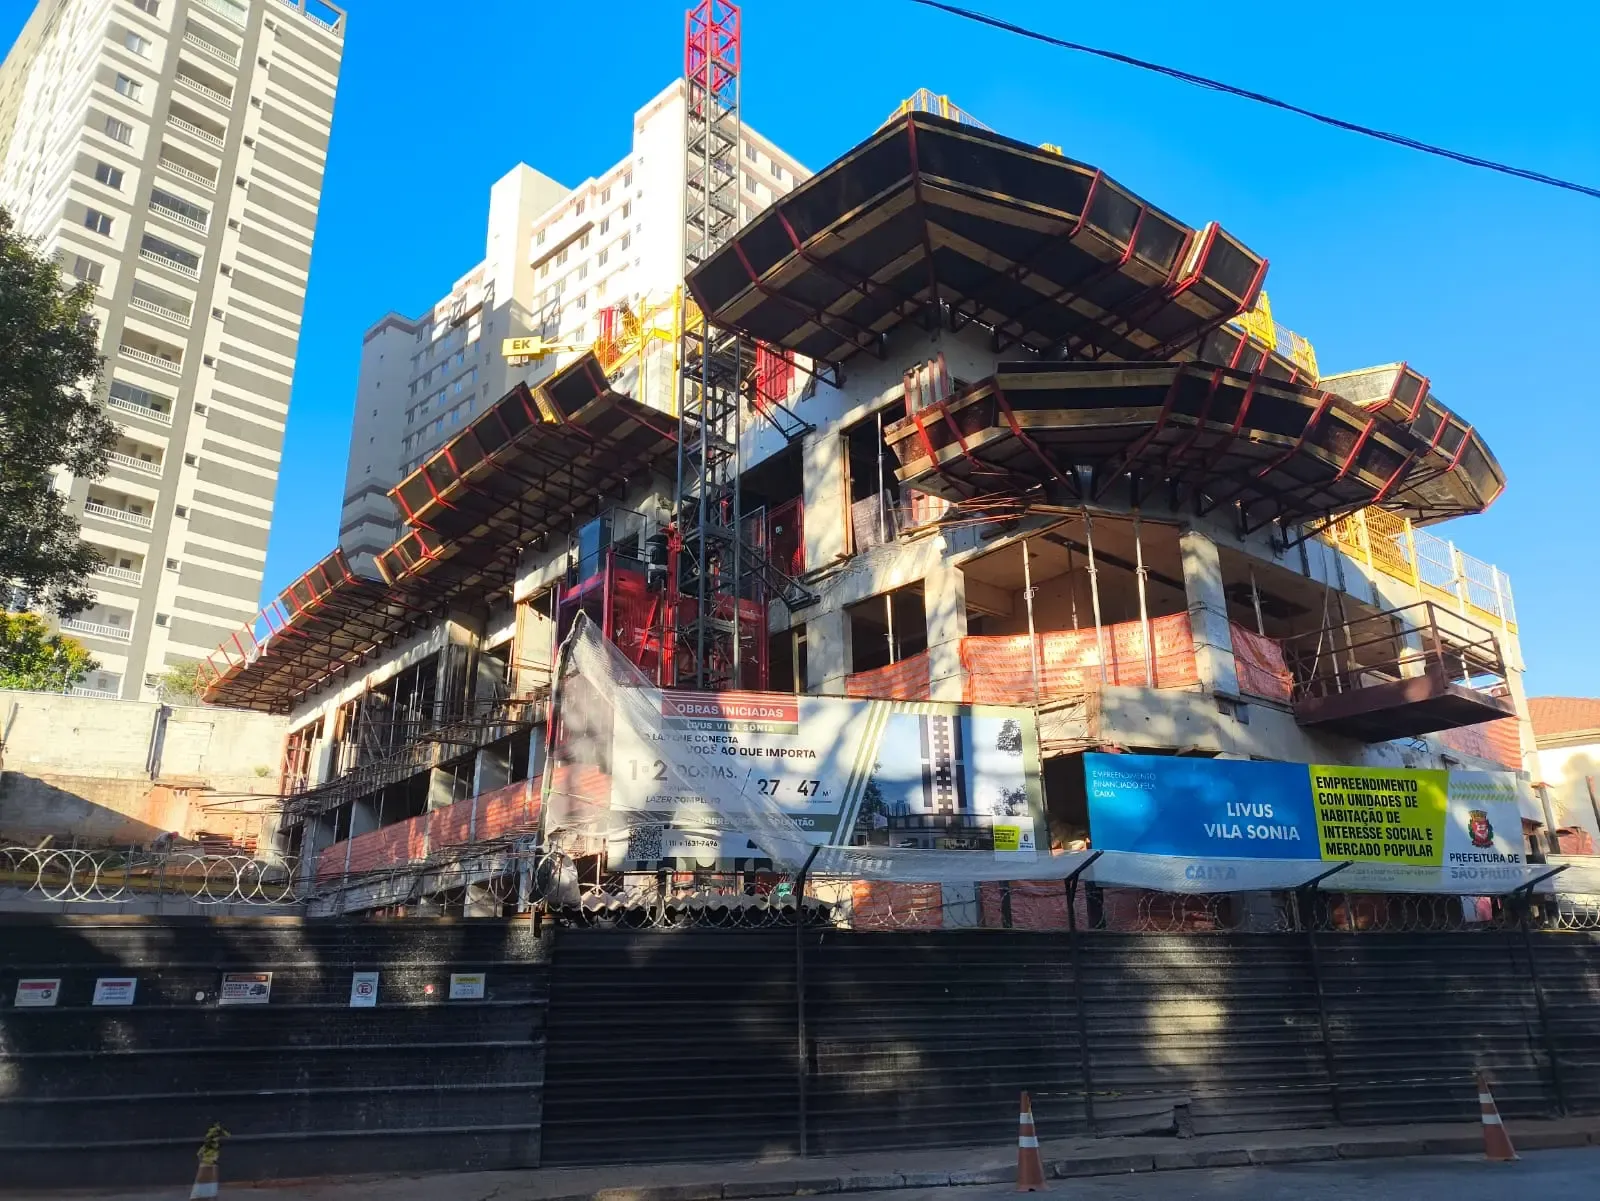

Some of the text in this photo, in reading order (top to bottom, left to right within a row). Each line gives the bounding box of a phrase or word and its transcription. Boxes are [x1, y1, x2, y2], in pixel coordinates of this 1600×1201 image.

[512, 339, 531, 350] EK
[676, 703, 784, 718] OBRAS INICIADAS
[716, 722, 739, 732] VILA
[743, 723, 775, 733] SONIA
[694, 734, 739, 744] CONECTA
[720, 746, 736, 756] AO
[739, 747, 763, 757] QUE
[765, 748, 816, 759] IMPORTA
[653, 759, 668, 781] 2
[1092, 770, 1156, 781] EMPREENDIMENTO
[757, 778, 780, 796] 27
[797, 779, 820, 797] 47
[1093, 780, 1139, 789] FINANCIADO
[1315, 775, 1418, 792] EMPREENDIMENTO
[646, 795, 672, 804] LAZER
[1094, 789, 1116, 797] CAIXA
[1318, 792, 1418, 808] COM UNIDADES DE
[1226, 802, 1274, 818] LIVUS
[1320, 808, 1401, 826] HABITAÇÃO DE
[1203, 823, 1301, 841] VILA SONIA
[1323, 825, 1433, 841] INTERESSE SOCIAL E
[1325, 842, 1433, 857] MERCADO POPULAR
[1449, 852, 1520, 864] PREFEITURA DE
[1450, 863, 1478, 880] SÃO
